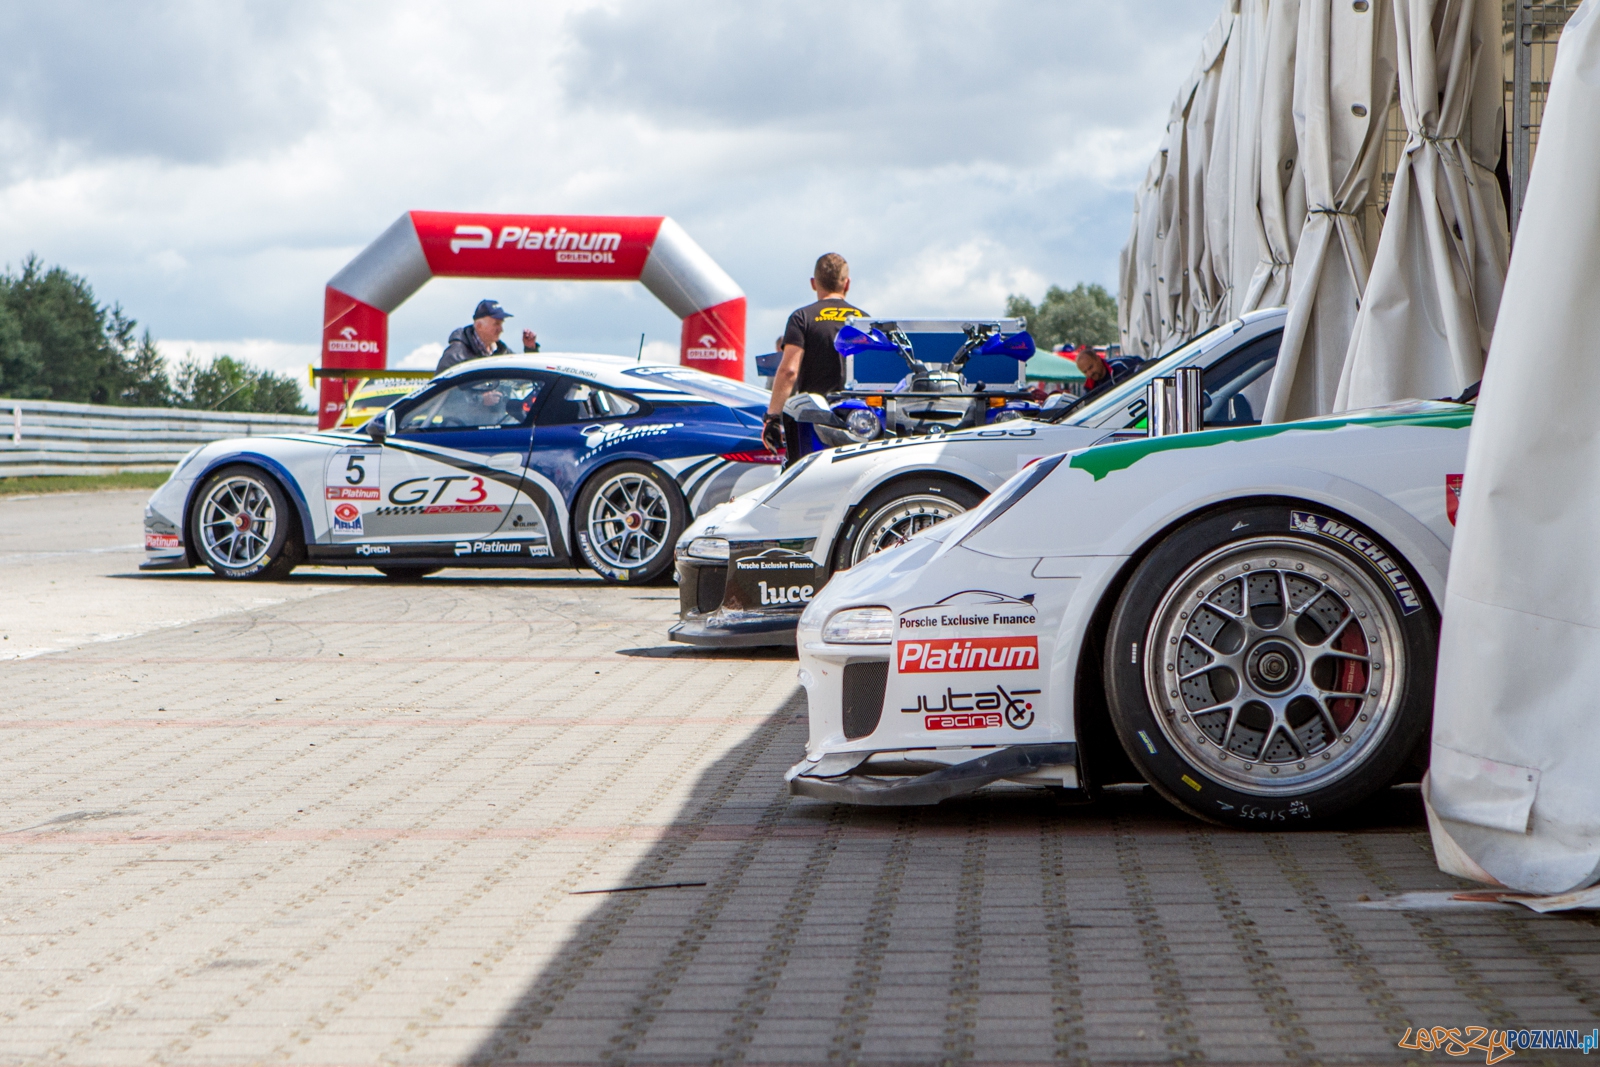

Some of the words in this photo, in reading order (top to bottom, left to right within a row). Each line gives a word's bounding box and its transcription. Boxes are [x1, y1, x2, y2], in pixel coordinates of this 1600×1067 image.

[496, 226, 622, 250] Platinum
[606, 430, 668, 448] NUTRITION
[345, 455, 365, 485] 5
[341, 487, 379, 499] Platinum
[388, 475, 488, 506] GT3
[427, 505, 496, 514] POLAND
[145, 535, 180, 548] Platinum
[473, 542, 522, 553] Platinum
[761, 561, 789, 569] Exclusive
[789, 561, 814, 569] Finance
[1321, 520, 1420, 607] MICHELIN
[900, 616, 938, 629] Porsche
[941, 614, 989, 626] Exclusive
[993, 613, 1036, 624] Finance
[900, 641, 1036, 670] Platinum
